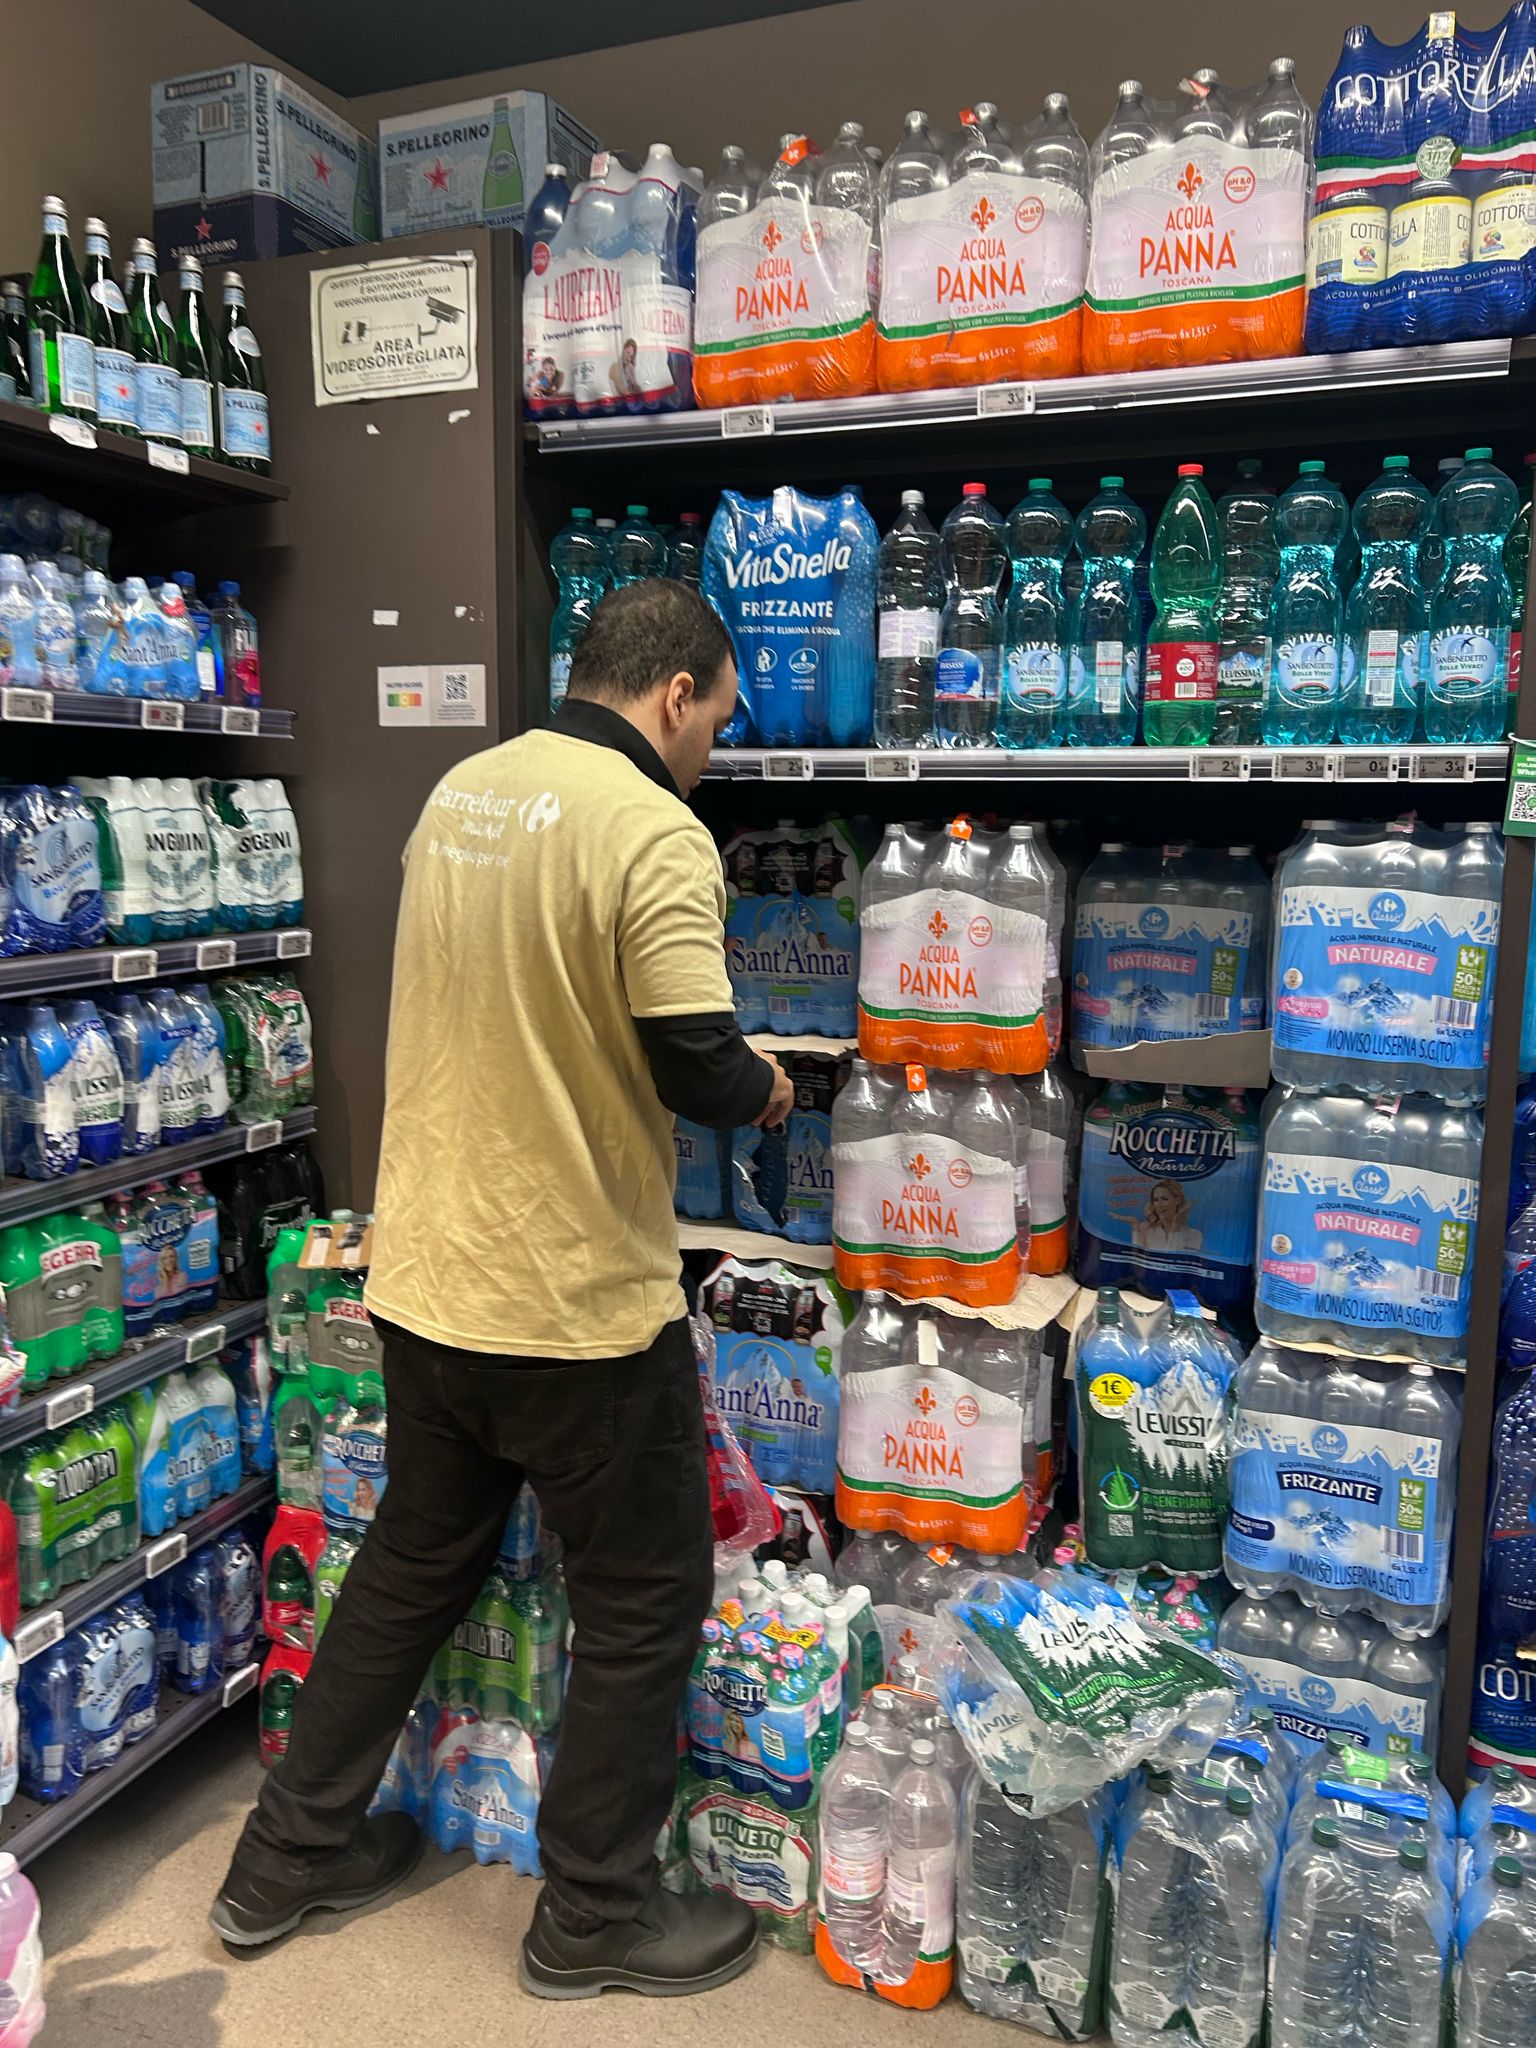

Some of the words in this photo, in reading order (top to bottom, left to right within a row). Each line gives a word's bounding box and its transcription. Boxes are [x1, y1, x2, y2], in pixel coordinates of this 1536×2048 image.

[386, 122, 491, 158] S.PELLEGRINO
[1165, 206, 1214, 233] ACQUA
[960, 239, 1007, 262] ACQUA
[1139, 231, 1238, 279] PANNA
[755, 257, 793, 281] ACQUA
[936, 258, 1027, 305] PANNA
[1162, 276, 1213, 289] TOSCANA
[543, 267, 623, 324] LAURETANA
[736, 279, 810, 323] PANNA
[1325, 290, 1360, 301] ACQUA
[1361, 281, 1407, 298] MINERALE
[1410, 274, 1461, 287] NATURALE
[956, 301, 1008, 315] TOSCANA
[373, 336, 414, 354] AREA
[325, 344, 466, 376] VIDEOSORVEGLIATA
[725, 537, 852, 590] VitaSnella
[740, 600, 834, 618] FRIZZANTE
[1437, 624, 1490, 641] VIVACI
[1220, 668, 1263, 679] LEVISSIMA
[429, 783, 516, 818] Carrefour
[731, 938, 850, 976] Sant'Anna
[919, 946, 961, 964] ACQUA
[1329, 934, 1357, 943] ACQUA
[1357, 933, 1396, 945] MINERALE
[1396, 937, 1438, 954] NATURALE
[1112, 955, 1192, 973] NATURALE
[1335, 946, 1430, 972] NATURALE
[900, 962, 978, 999] PANNA
[1455, 971, 1482, 987] 50%
[1326, 1029, 1371, 1051] MONVISO
[1372, 1033, 1418, 1056] LUSERNA
[1110, 1121, 1236, 1158] ROCCHETTA
[901, 1184, 942, 1204] ACQUA
[881, 1199, 960, 1238] PANNA
[1315, 1202, 1342, 1211] ACQUA
[1342, 1203, 1381, 1216] MINERALE
[1381, 1209, 1421, 1225] NATURALE
[1321, 1214, 1414, 1242] NATURALE
[1314, 1293, 1359, 1319] MONVISO
[1359, 1299, 1404, 1323] LUSERNA
[1100, 1379, 1123, 1395] 1€
[715, 1379, 819, 1427] ant'Anna
[905, 1420, 947, 1442] ACQUA
[1135, 1406, 1213, 1438] LEVISSI
[884, 1433, 964, 1480] PANNA
[1278, 1461, 1304, 1470] ACQUA
[1304, 1463, 1342, 1476] MINERALE
[1342, 1468, 1382, 1484] NATURALE
[1281, 1473, 1378, 1503] FRIZZANTE
[1288, 1552, 1333, 1584] MONVISO
[1334, 1563, 1378, 1587] LUSERNA
[1274, 1714, 1365, 1744] FRIZZAE
[715, 1816, 780, 1850] ULIVETO
